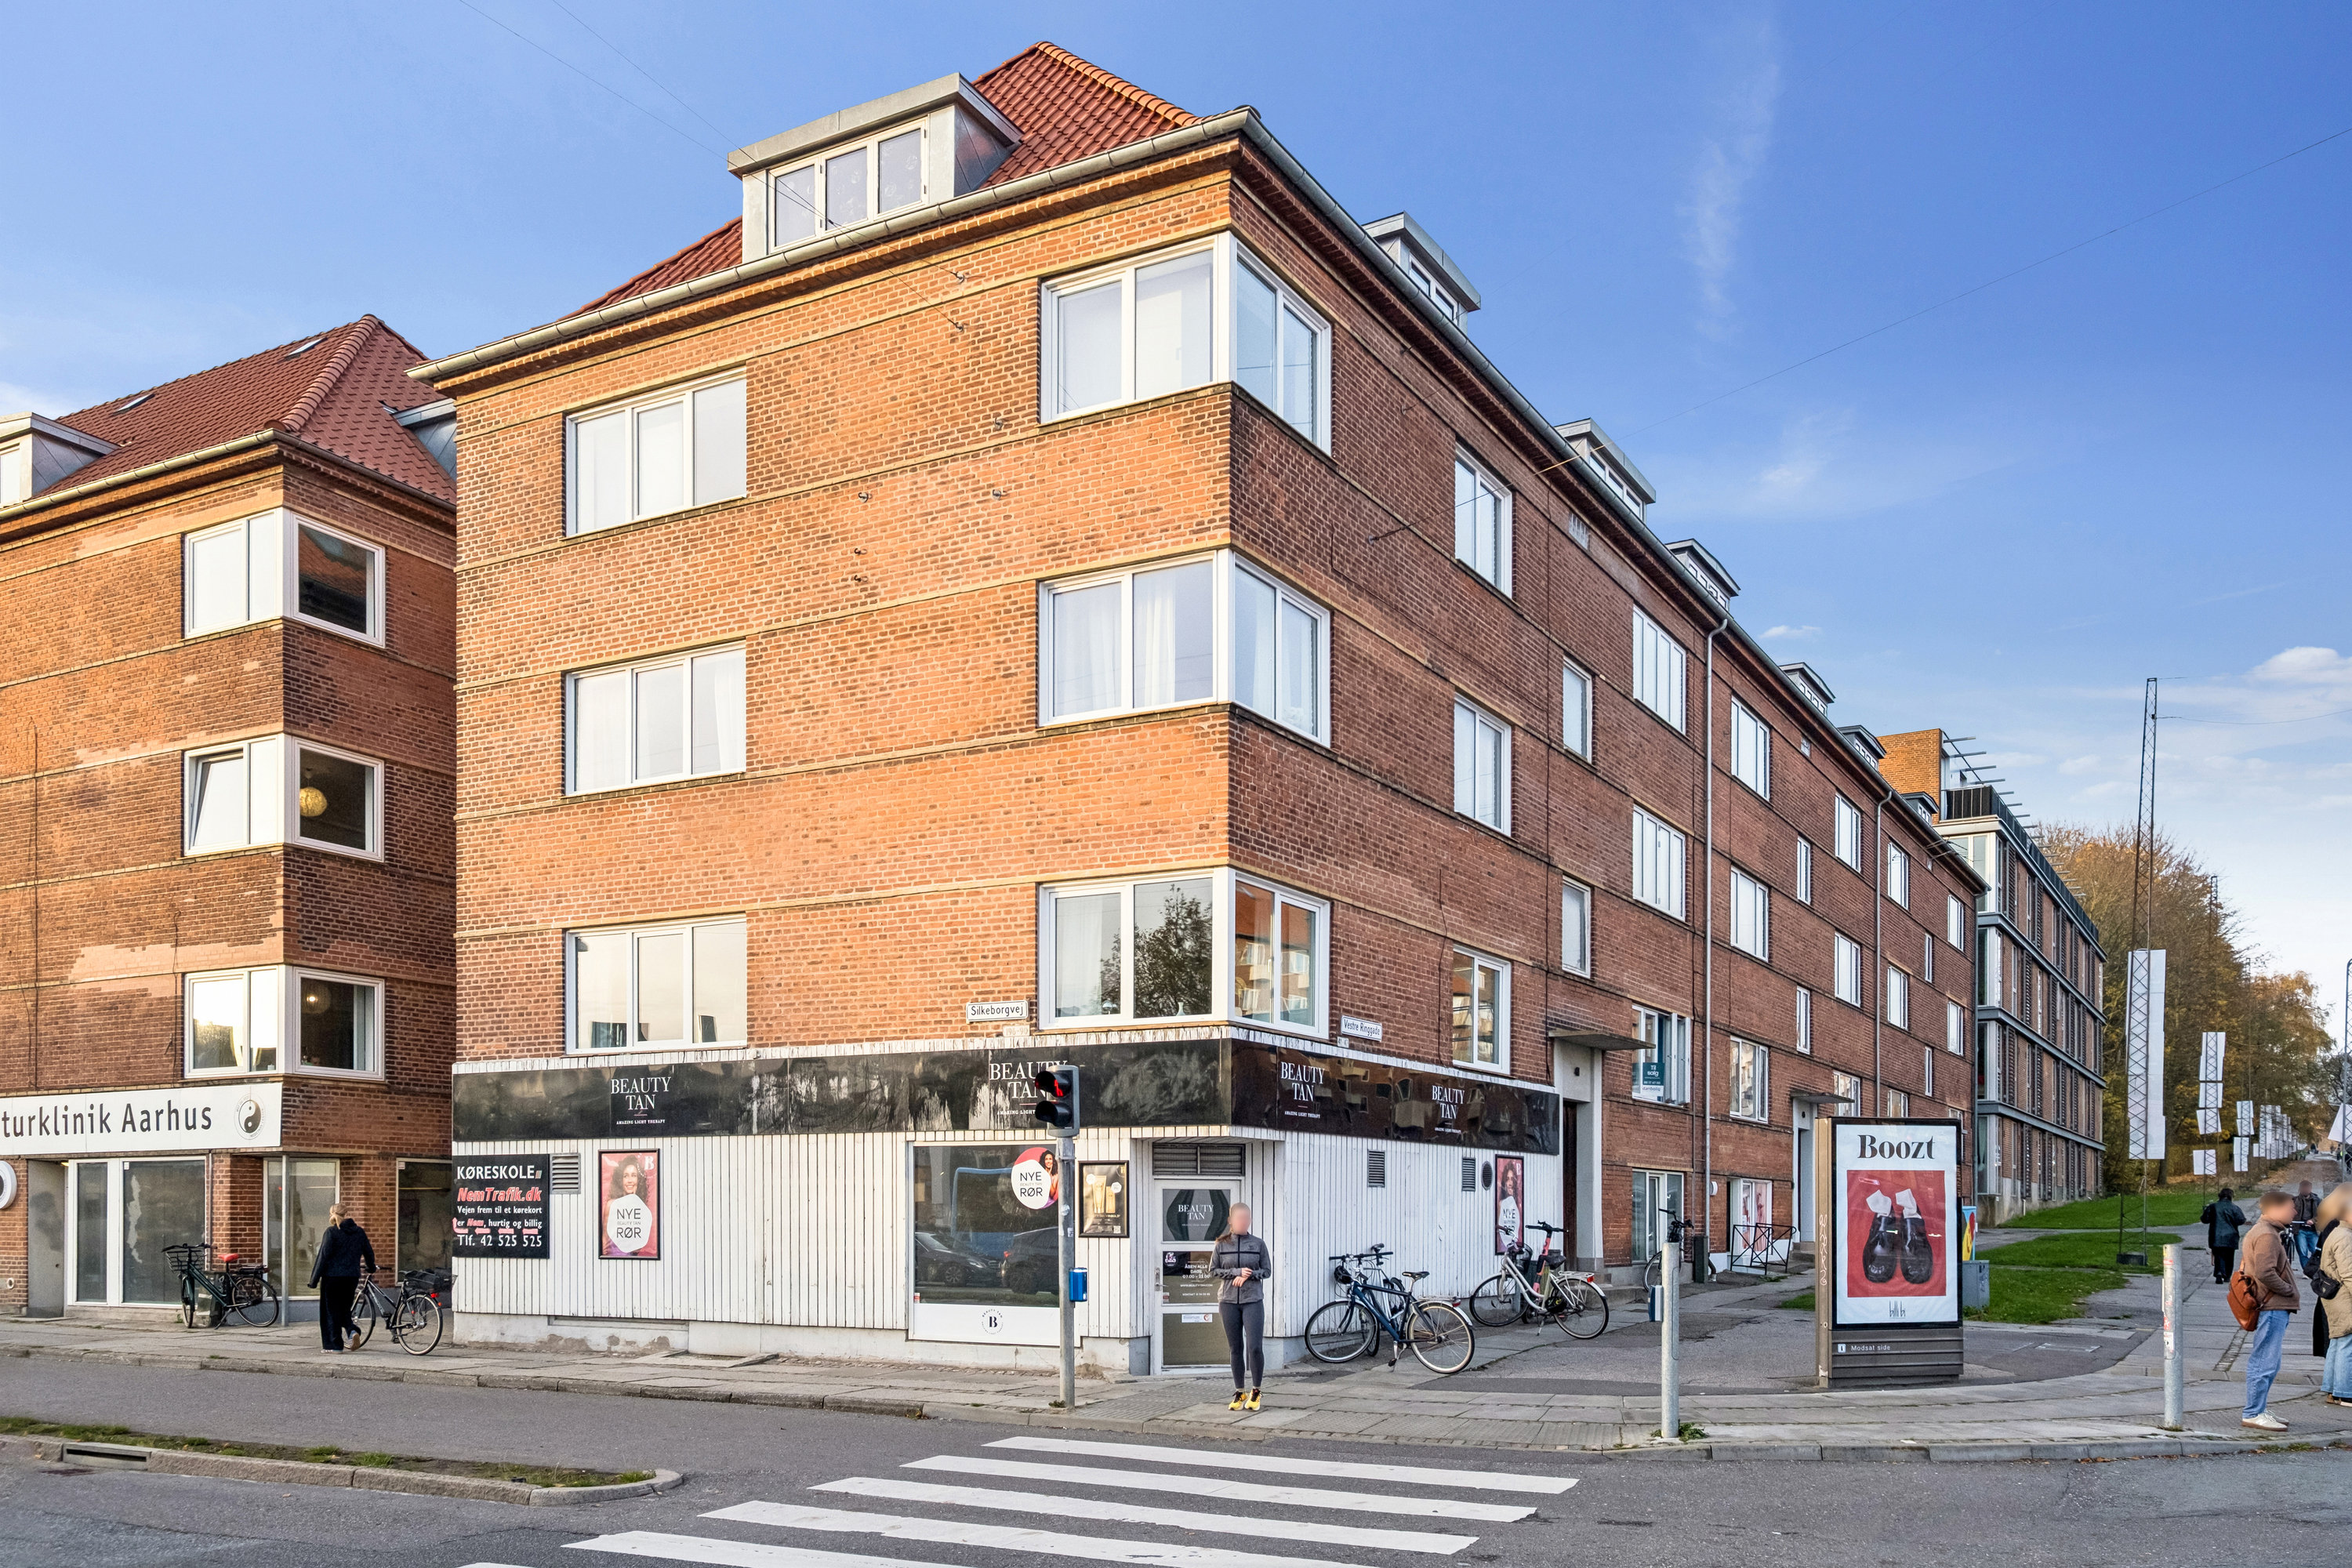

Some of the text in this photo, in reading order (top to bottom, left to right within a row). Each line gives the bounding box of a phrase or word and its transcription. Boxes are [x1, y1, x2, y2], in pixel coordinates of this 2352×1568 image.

[971, 1003, 1023, 1016] Silkeborgvej
[1344, 1019, 1381, 1036] Vestre Ringgade
[989, 1060, 1068, 1080] BEAU
[1280, 1061, 1325, 1084] BEAUTY
[611, 1076, 672, 1094] BEAUTY
[1291, 1083, 1314, 1102] TAN
[626, 1094, 656, 1110] TAN
[1432, 1085, 1465, 1105] BEAUTY
[122, 1099, 212, 1133] Aarhus
[1440, 1103, 1457, 1120] TAN
[1857, 1134, 1936, 1160] Boozt
[644, 1156, 655, 1171] B
[457, 1165, 535, 1180] KØRESKOLE
[1020, 1171, 1042, 1181] NYE
[457, 1186, 542, 1202] NemTrafik.dk
[1020, 1187, 1043, 1197] RØR
[457, 1206, 475, 1215] Vejen
[477, 1206, 492, 1214] frem
[513, 1206, 543, 1214] kørekort
[616, 1208, 641, 1220] NYE
[1503, 1208, 1515, 1219] NYE
[488, 1218, 510, 1229] hurtig
[513, 1221, 522, 1229] og
[524, 1218, 543, 1229] billig
[616, 1227, 641, 1239] RØR
[457, 1235, 543, 1247] Tlf. 42 525 525
[989, 1316, 998, 1328] B
